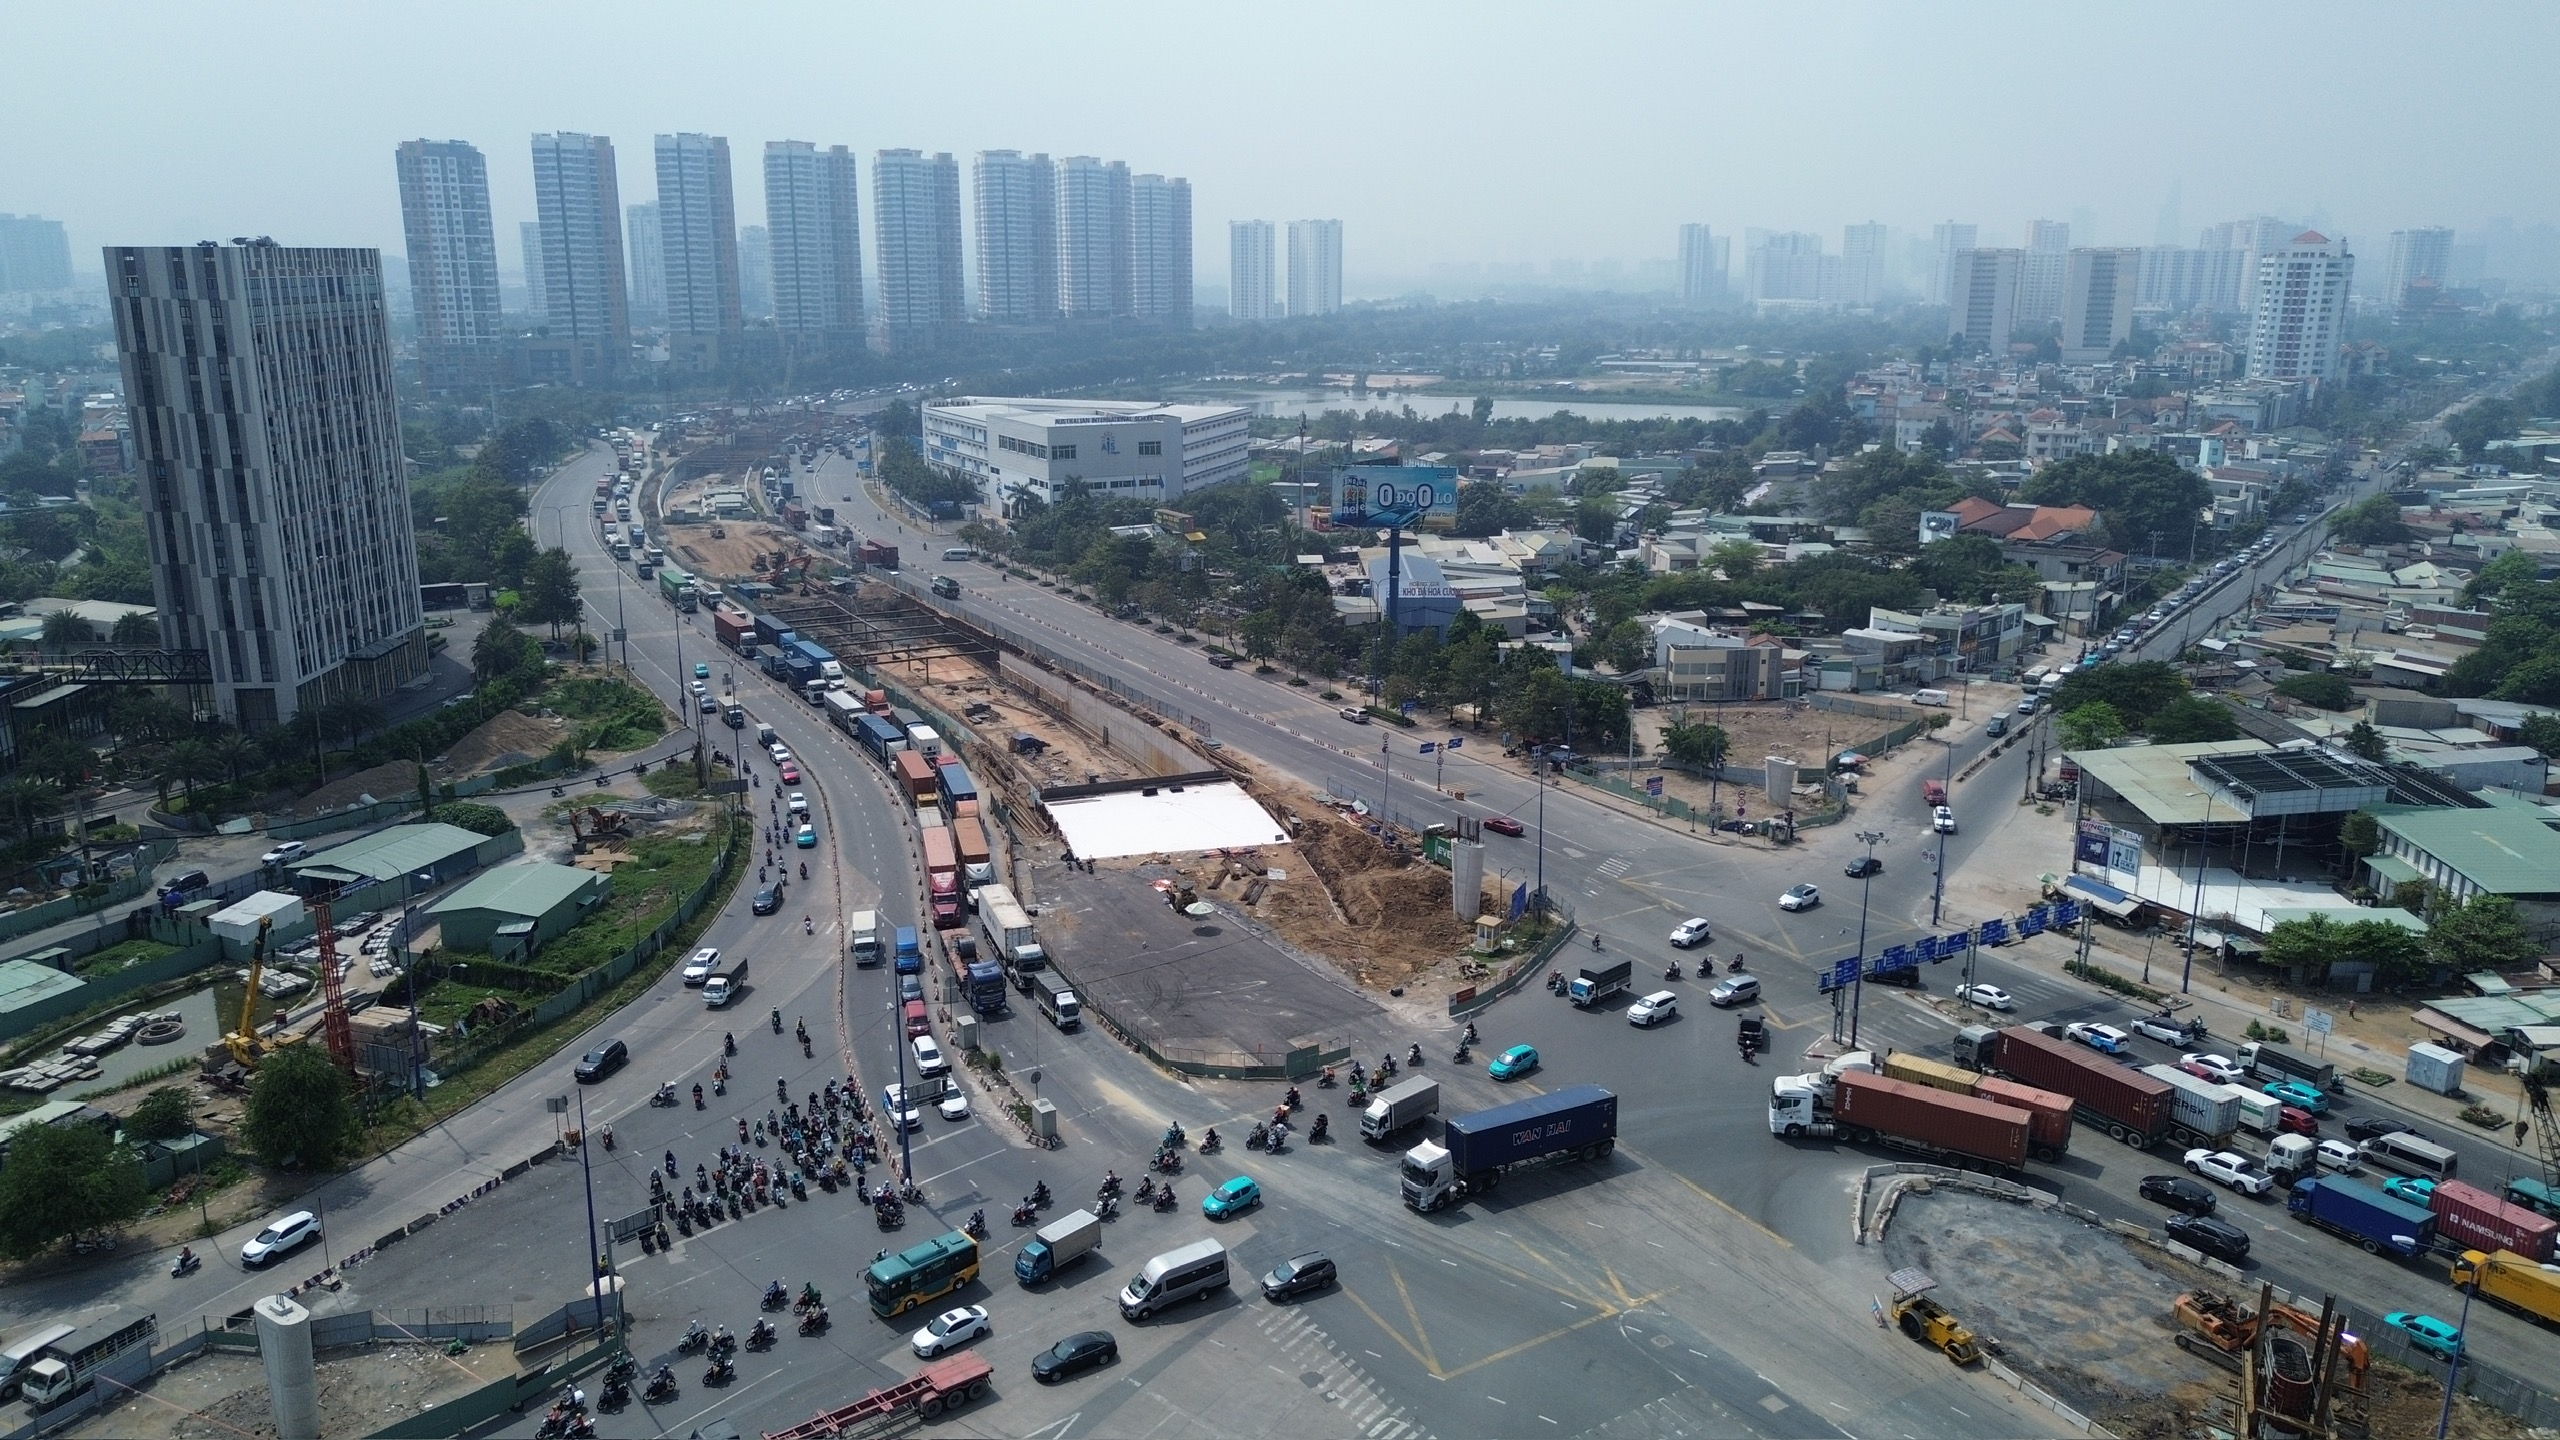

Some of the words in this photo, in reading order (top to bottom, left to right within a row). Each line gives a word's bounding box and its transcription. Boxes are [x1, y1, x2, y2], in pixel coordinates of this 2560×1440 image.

[1435, 492, 1453, 504] LO
[1402, 587, 1416, 596] KHO
[1437, 845, 1452, 860] EVE
[2173, 1096, 2206, 1118] ERSK
[1513, 1127, 1542, 1146] WAN
[1546, 1119, 1572, 1137] HAI
[2461, 1218, 2514, 1247] NAMSUNG
